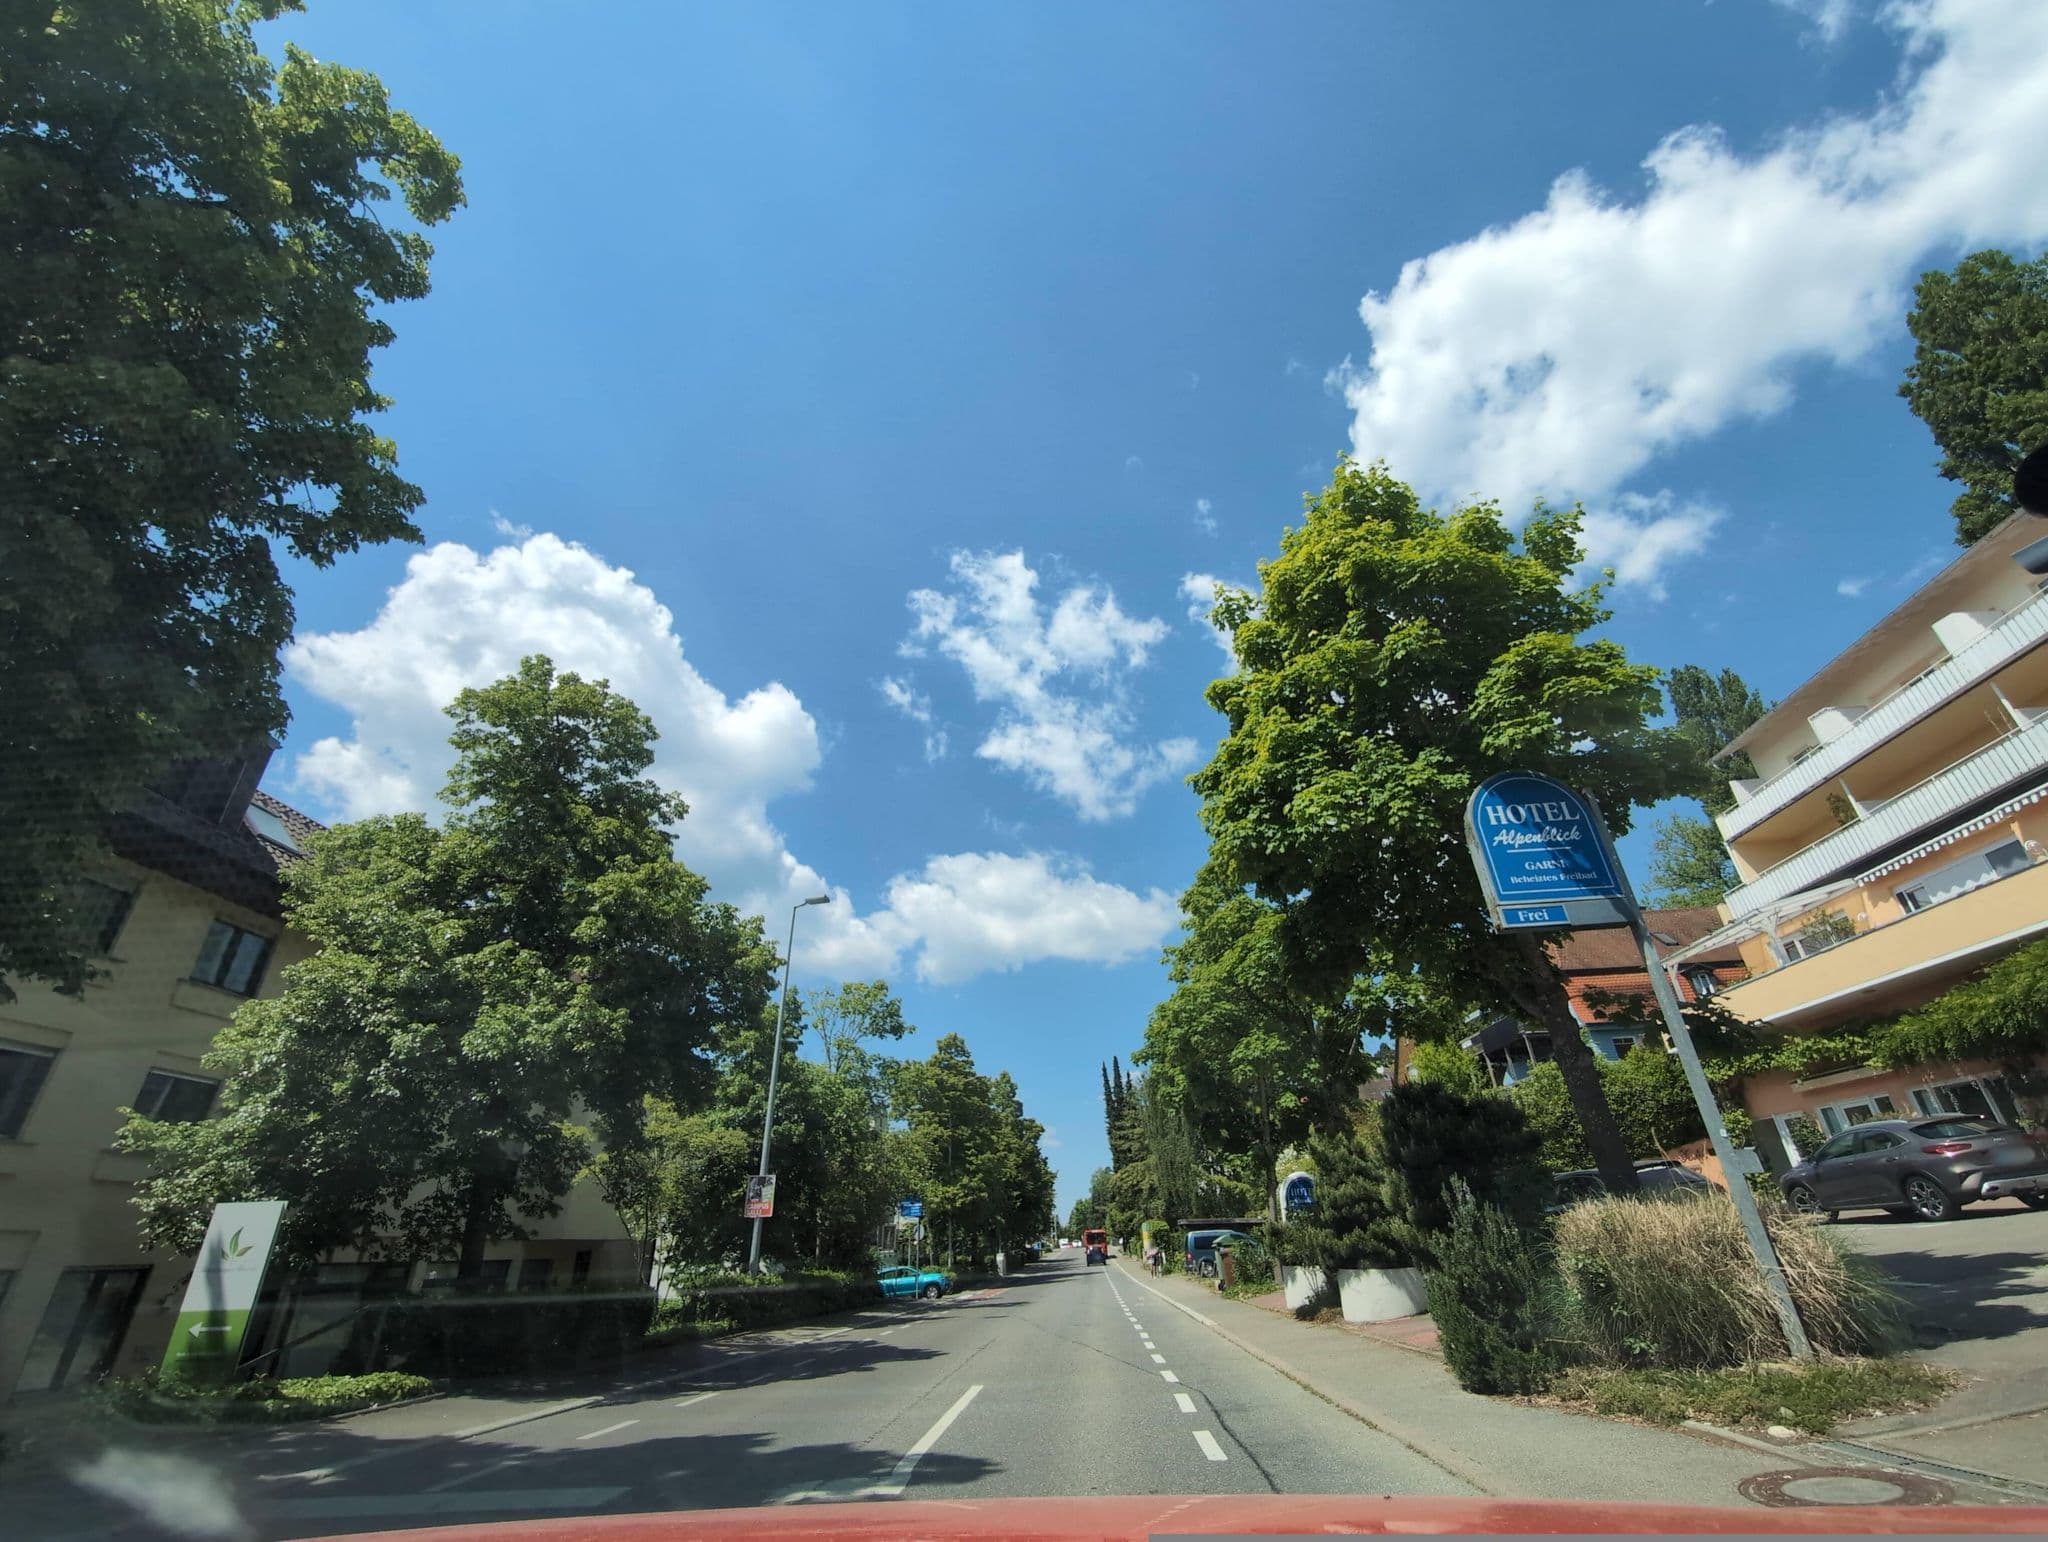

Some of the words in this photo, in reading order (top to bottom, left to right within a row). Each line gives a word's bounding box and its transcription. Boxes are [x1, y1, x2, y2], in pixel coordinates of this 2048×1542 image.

[1486, 802, 1580, 825] HOTEL
[1492, 825, 1581, 848] Alpenblick
[1510, 874, 1558, 884] Beheiztes
[1560, 871, 1597, 881] Freibad
[1518, 909, 1550, 922] Frei
